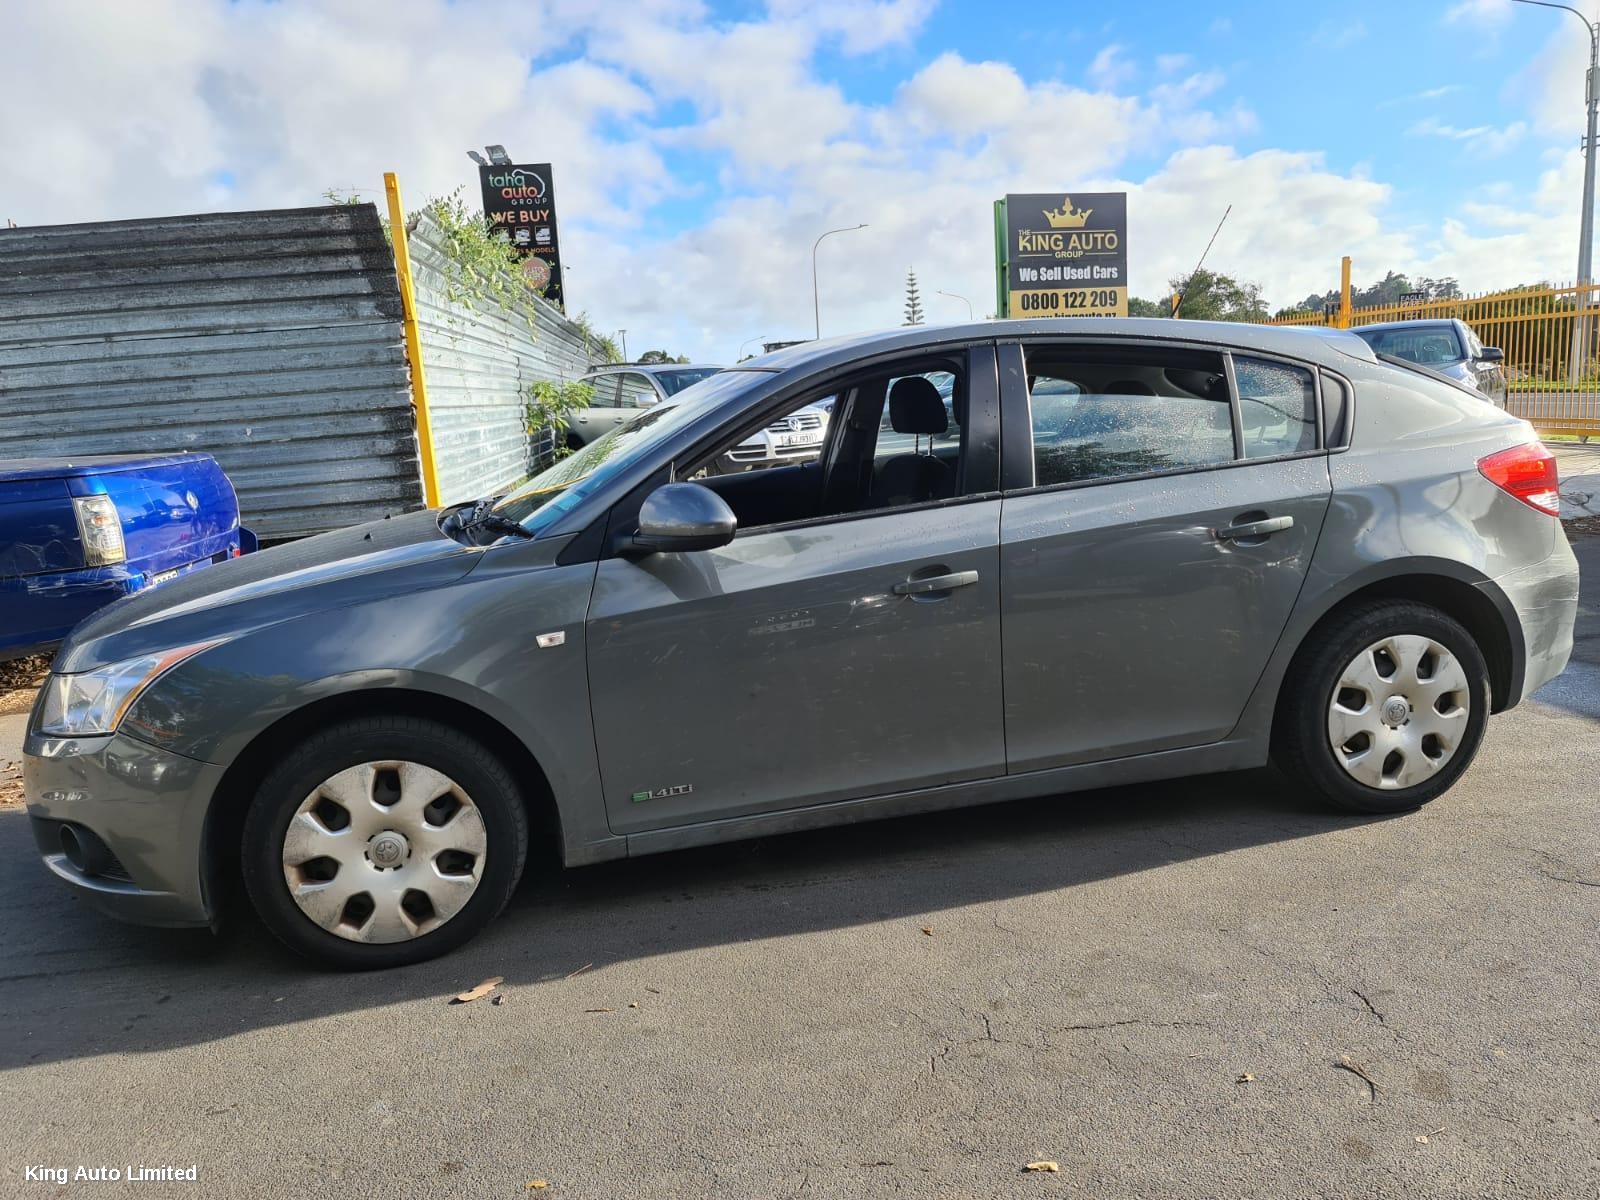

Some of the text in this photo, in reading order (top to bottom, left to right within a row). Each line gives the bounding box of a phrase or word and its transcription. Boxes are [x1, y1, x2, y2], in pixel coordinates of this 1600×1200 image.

[488, 172, 525, 187] taha
[501, 185, 538, 199] auto
[511, 197, 547, 206] GROUP
[490, 209, 549, 223] WE BUY
[1018, 233, 1118, 251] KING AUTO
[1054, 250, 1084, 258] GROUP
[1019, 265, 1118, 282] We Sell Used Cars
[1021, 290, 1118, 310] 0800 122 209
